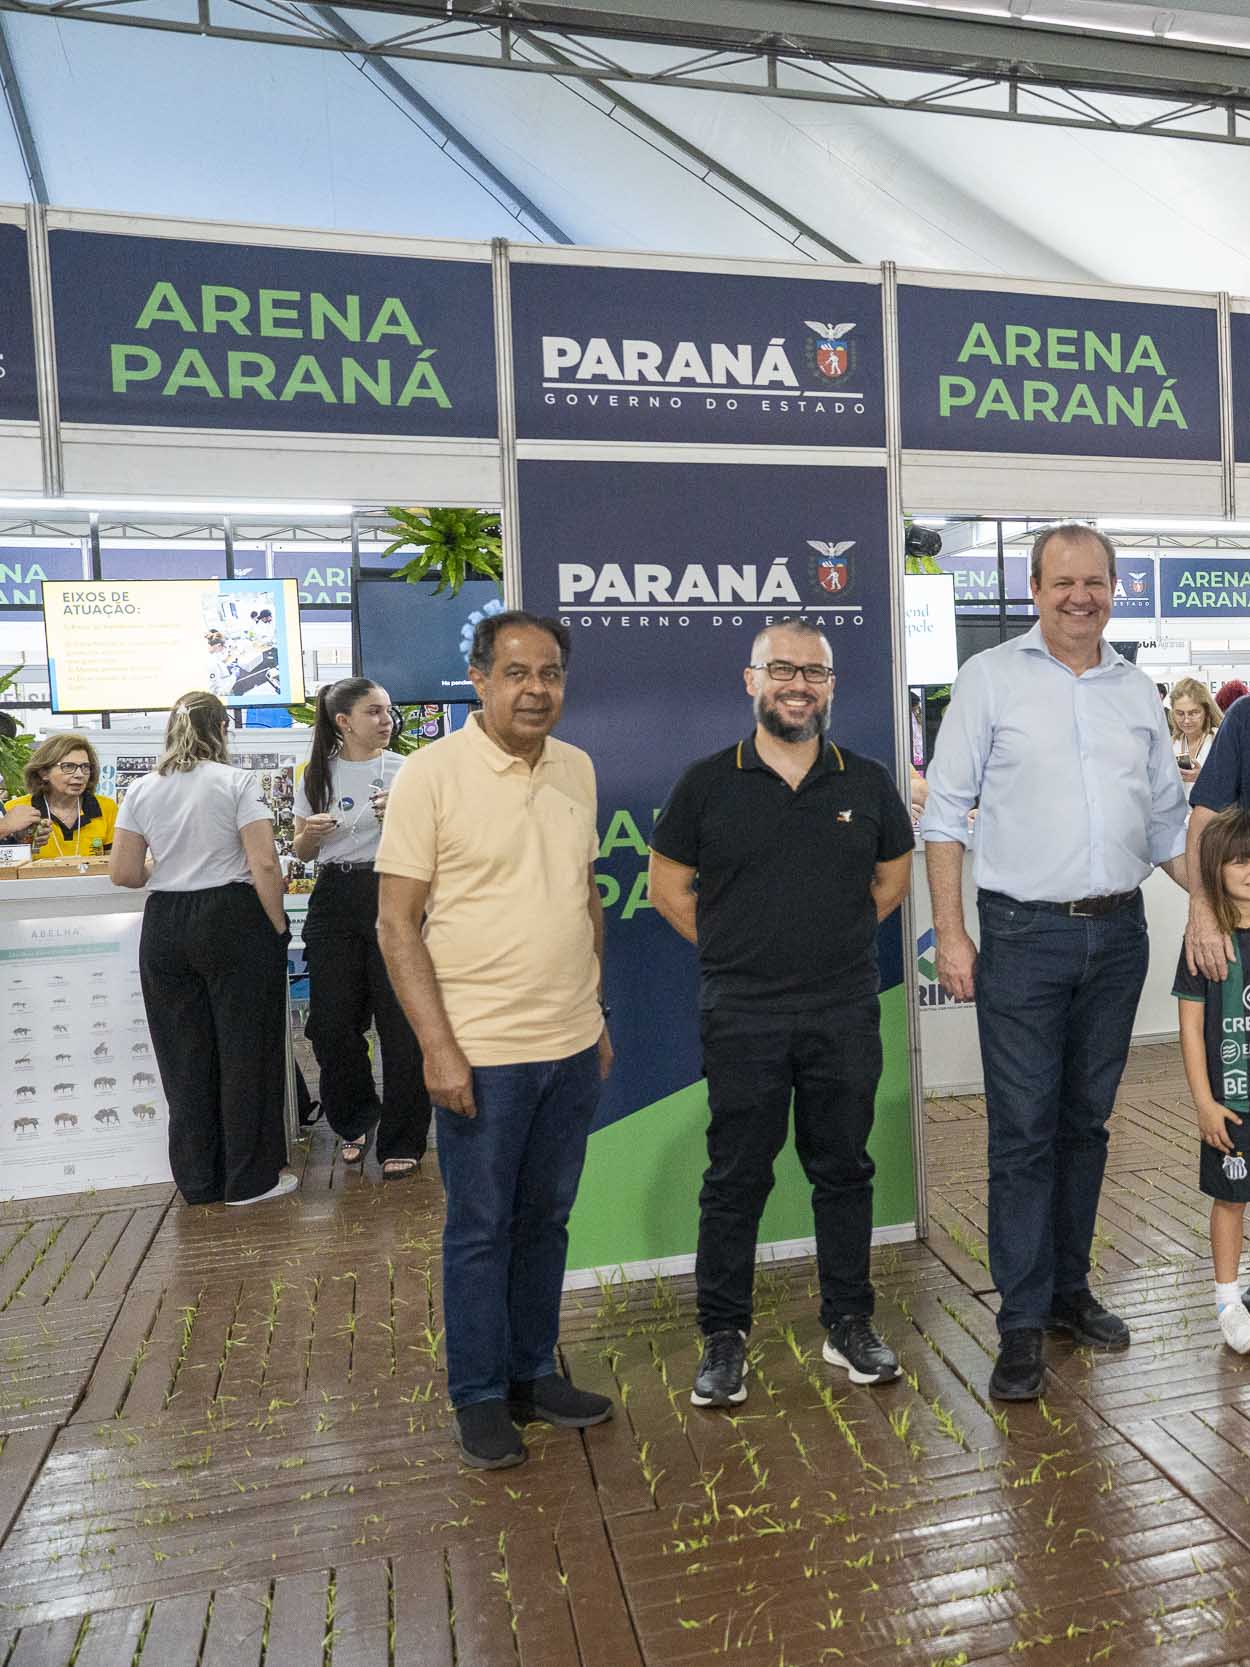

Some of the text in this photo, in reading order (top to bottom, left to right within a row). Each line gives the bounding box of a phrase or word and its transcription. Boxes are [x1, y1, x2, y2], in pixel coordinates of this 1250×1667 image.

[134, 281, 424, 346] ARENA
[542, 336, 800, 387] PARANÁ
[957, 322, 1168, 376] ARENA
[110, 343, 453, 409] PARANÁ
[544, 393, 865, 415] GOVERNO DO ESTADO
[939, 375, 1189, 430] PARANÁ
[558, 557, 801, 603] PARANÁ
[954, 570, 998, 588] ENA
[62, 591, 130, 602] EIXOS DE
[63, 602, 142, 618] ATUAÇÃO:
[560, 615, 690, 627] GOVERNO
[712, 616, 743, 627] DO
[1223, 1077, 1248, 1095] BE
